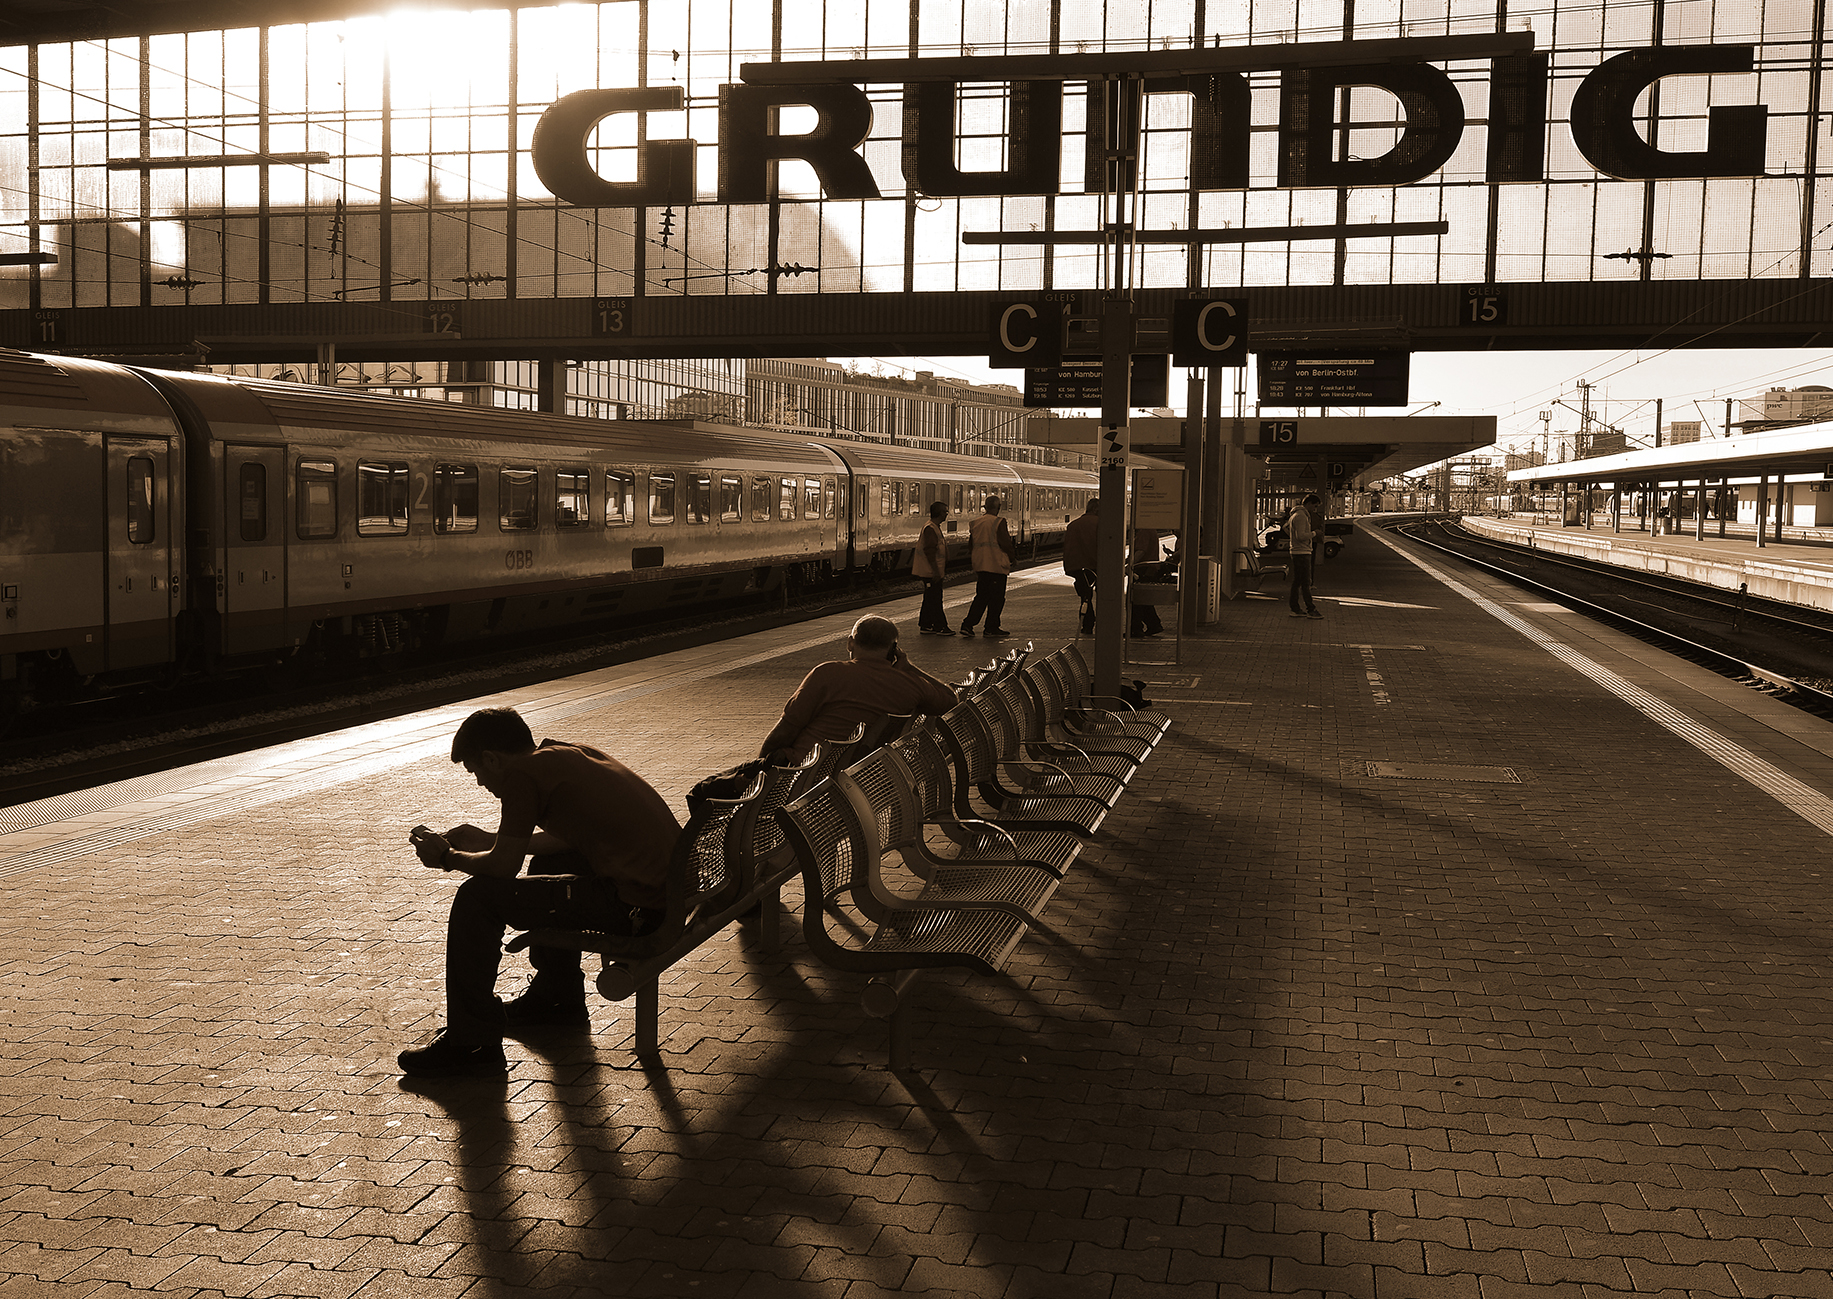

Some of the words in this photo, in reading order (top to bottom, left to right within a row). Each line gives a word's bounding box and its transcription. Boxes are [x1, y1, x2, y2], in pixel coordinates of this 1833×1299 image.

[532, 46, 1767, 206] GRUNDIG
[1045, 293, 1076, 302] GLEIS
[1467, 286, 1501, 296] GLEIS
[428, 303, 456, 312] GLEIS
[597, 300, 627, 309] GLEIS
[1469, 297, 1498, 322] 15
[35, 311, 60, 320] GLEIS
[430, 312, 454, 333] 12
[600, 310, 624, 333] 13
[40, 321, 55, 342] 11
[999, 303, 1038, 353] C
[1197, 301, 1237, 352] C
[1312, 369, 1359, 377] Berlin-Ostbf.
[1268, 422, 1294, 443] 15
[1333, 463, 1343, 476] D
[414, 472, 429, 510] 2
